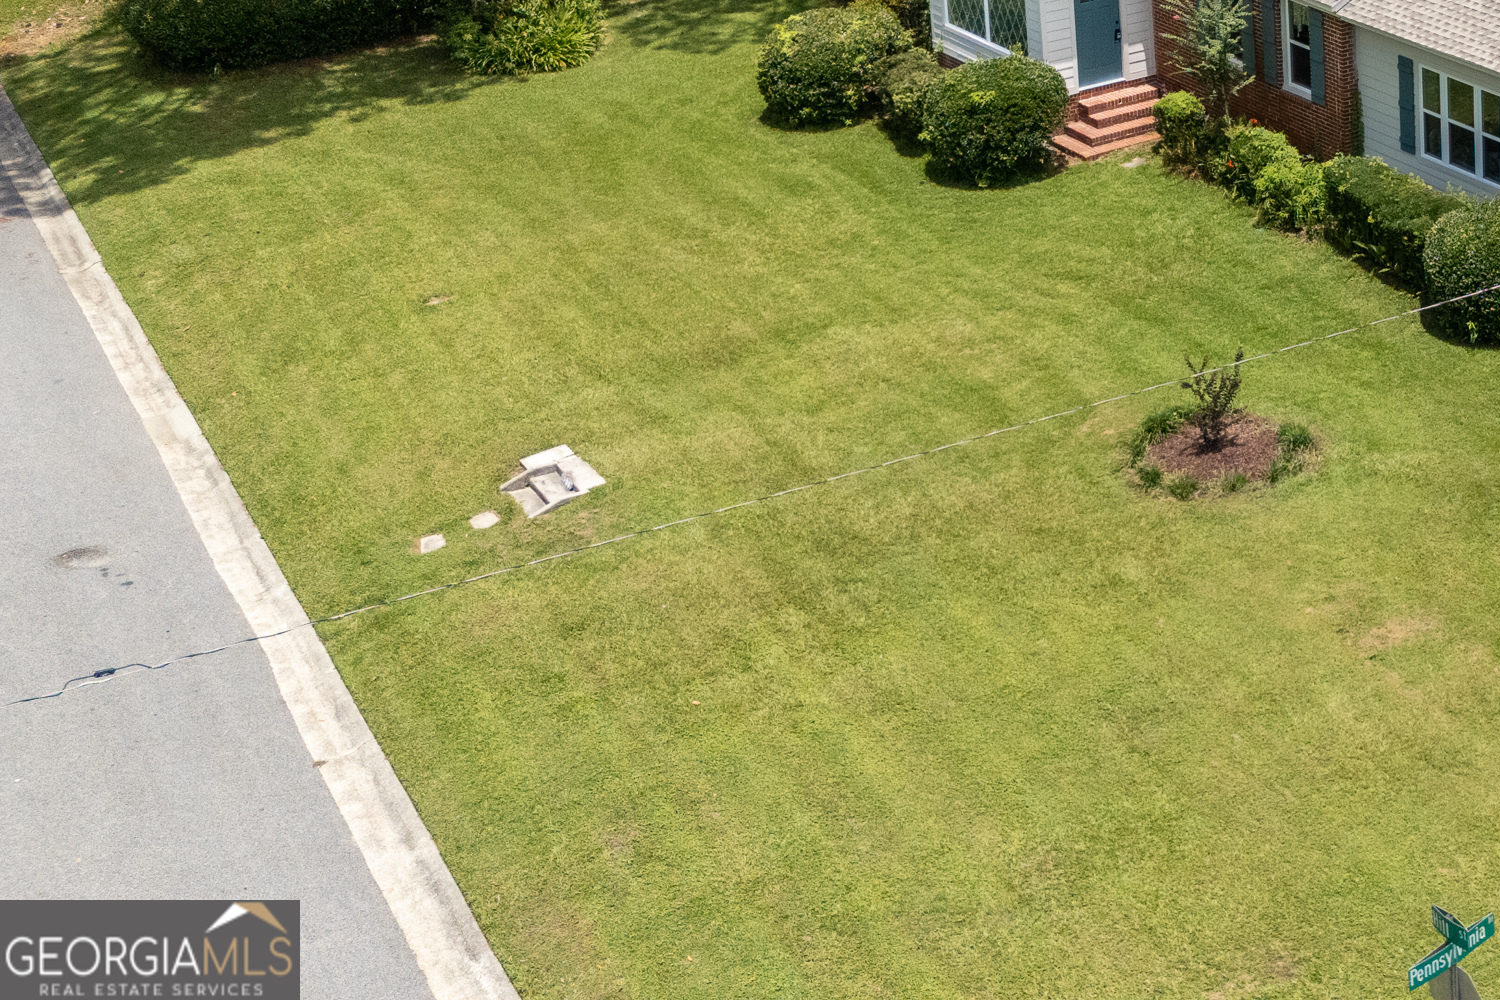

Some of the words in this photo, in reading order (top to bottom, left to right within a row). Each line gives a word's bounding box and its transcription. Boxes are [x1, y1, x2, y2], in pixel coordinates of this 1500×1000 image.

[1433, 911, 1450, 938] Hill
[1458, 930, 1467, 941] St
[1409, 926, 1486, 987] Pennsylvnia
